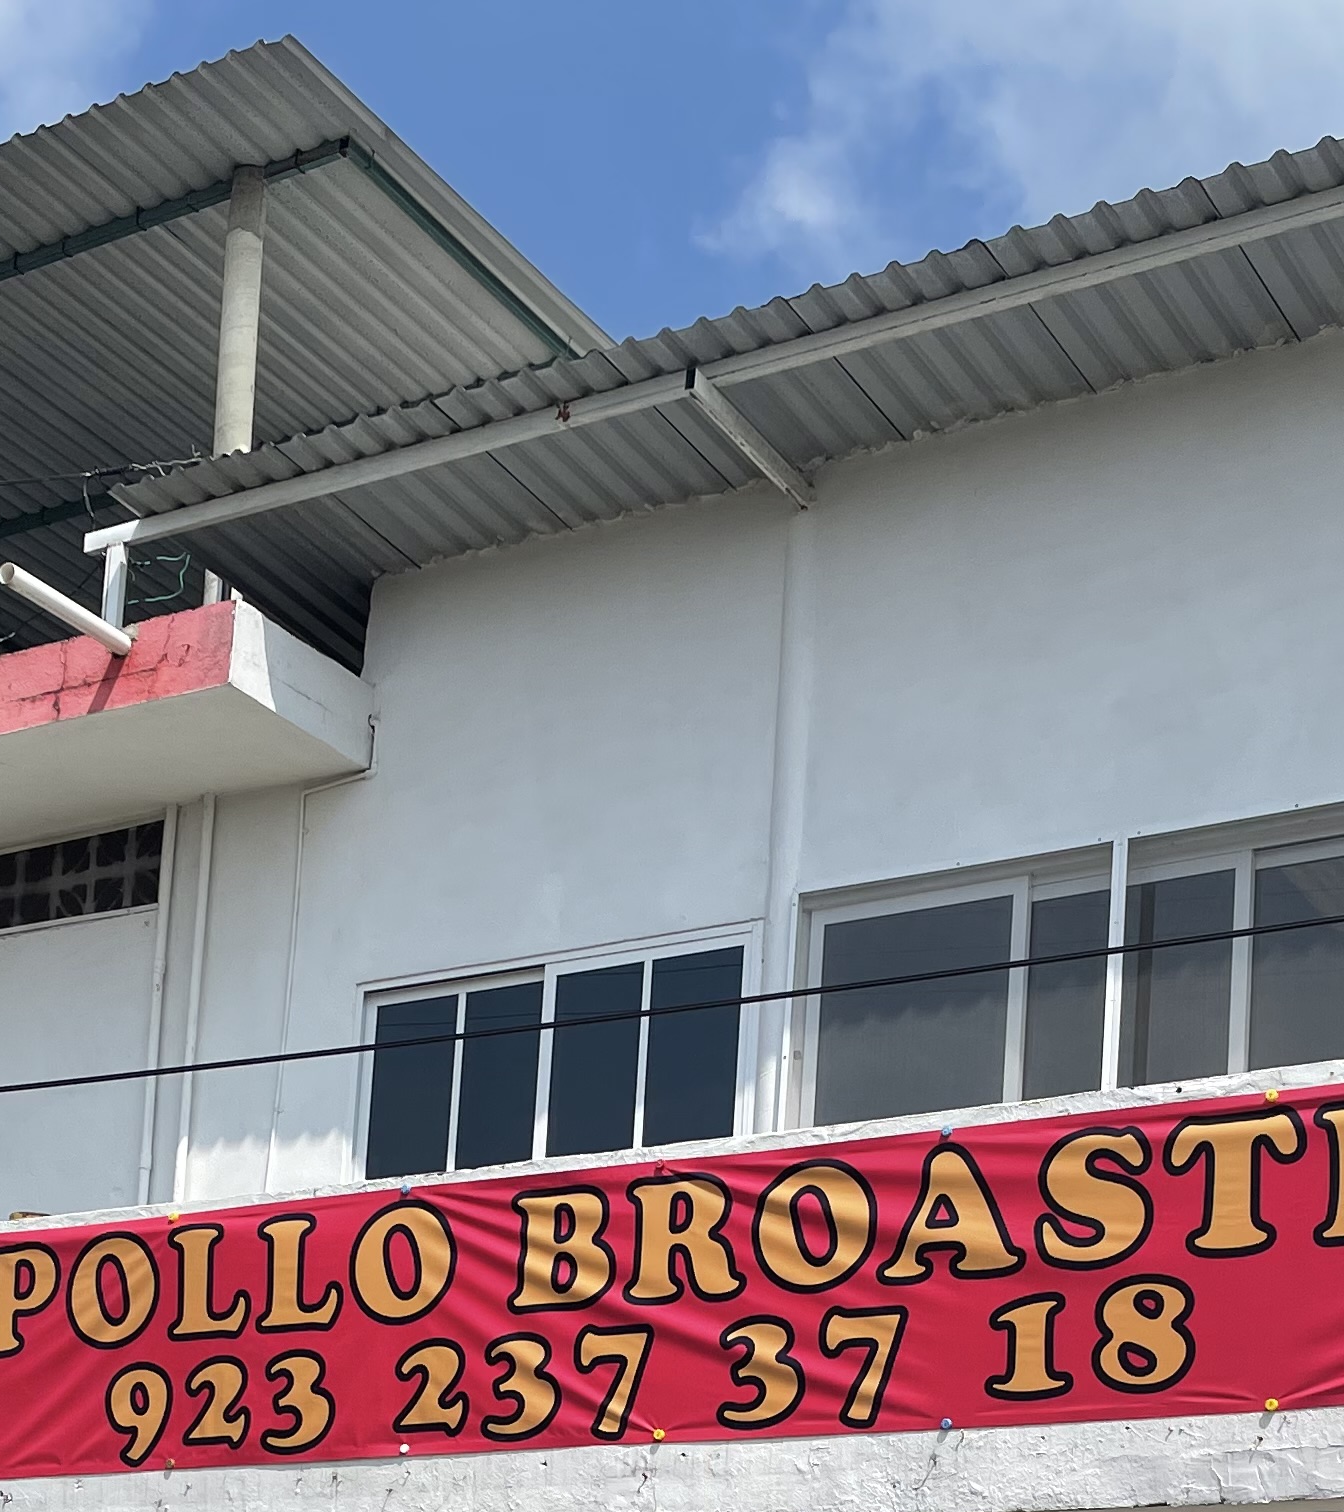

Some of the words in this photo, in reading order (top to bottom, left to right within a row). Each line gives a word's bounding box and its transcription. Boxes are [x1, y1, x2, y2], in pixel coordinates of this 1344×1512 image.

[105, 1348, 334, 1467] 923
[393, 1323, 654, 1442] 237
[717, 1304, 909, 1431] 37
[984, 1273, 1195, 1401] 18
